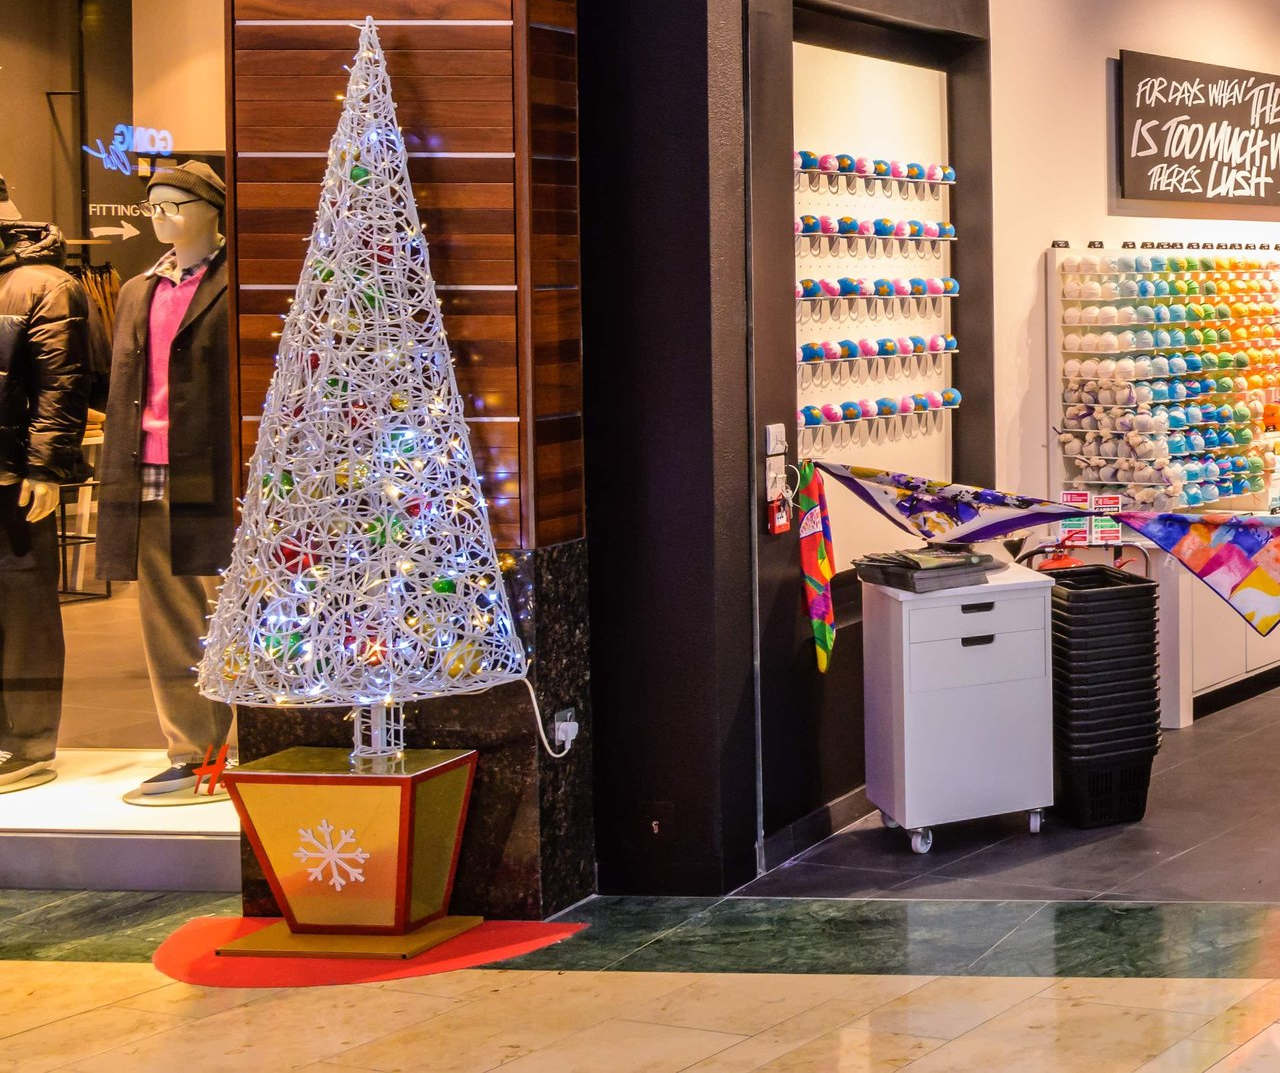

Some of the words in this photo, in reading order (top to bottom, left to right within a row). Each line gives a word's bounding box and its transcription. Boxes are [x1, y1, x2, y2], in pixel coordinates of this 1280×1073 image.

[1136, 77, 1167, 108] FOR
[1168, 78, 1205, 107] DAYS
[1208, 79, 1246, 108] WHEN
[1131, 118, 1160, 158] IS
[1161, 115, 1204, 159] TOO
[1206, 155, 1273, 198] LUSH
[89, 204, 140, 217] FITTING
